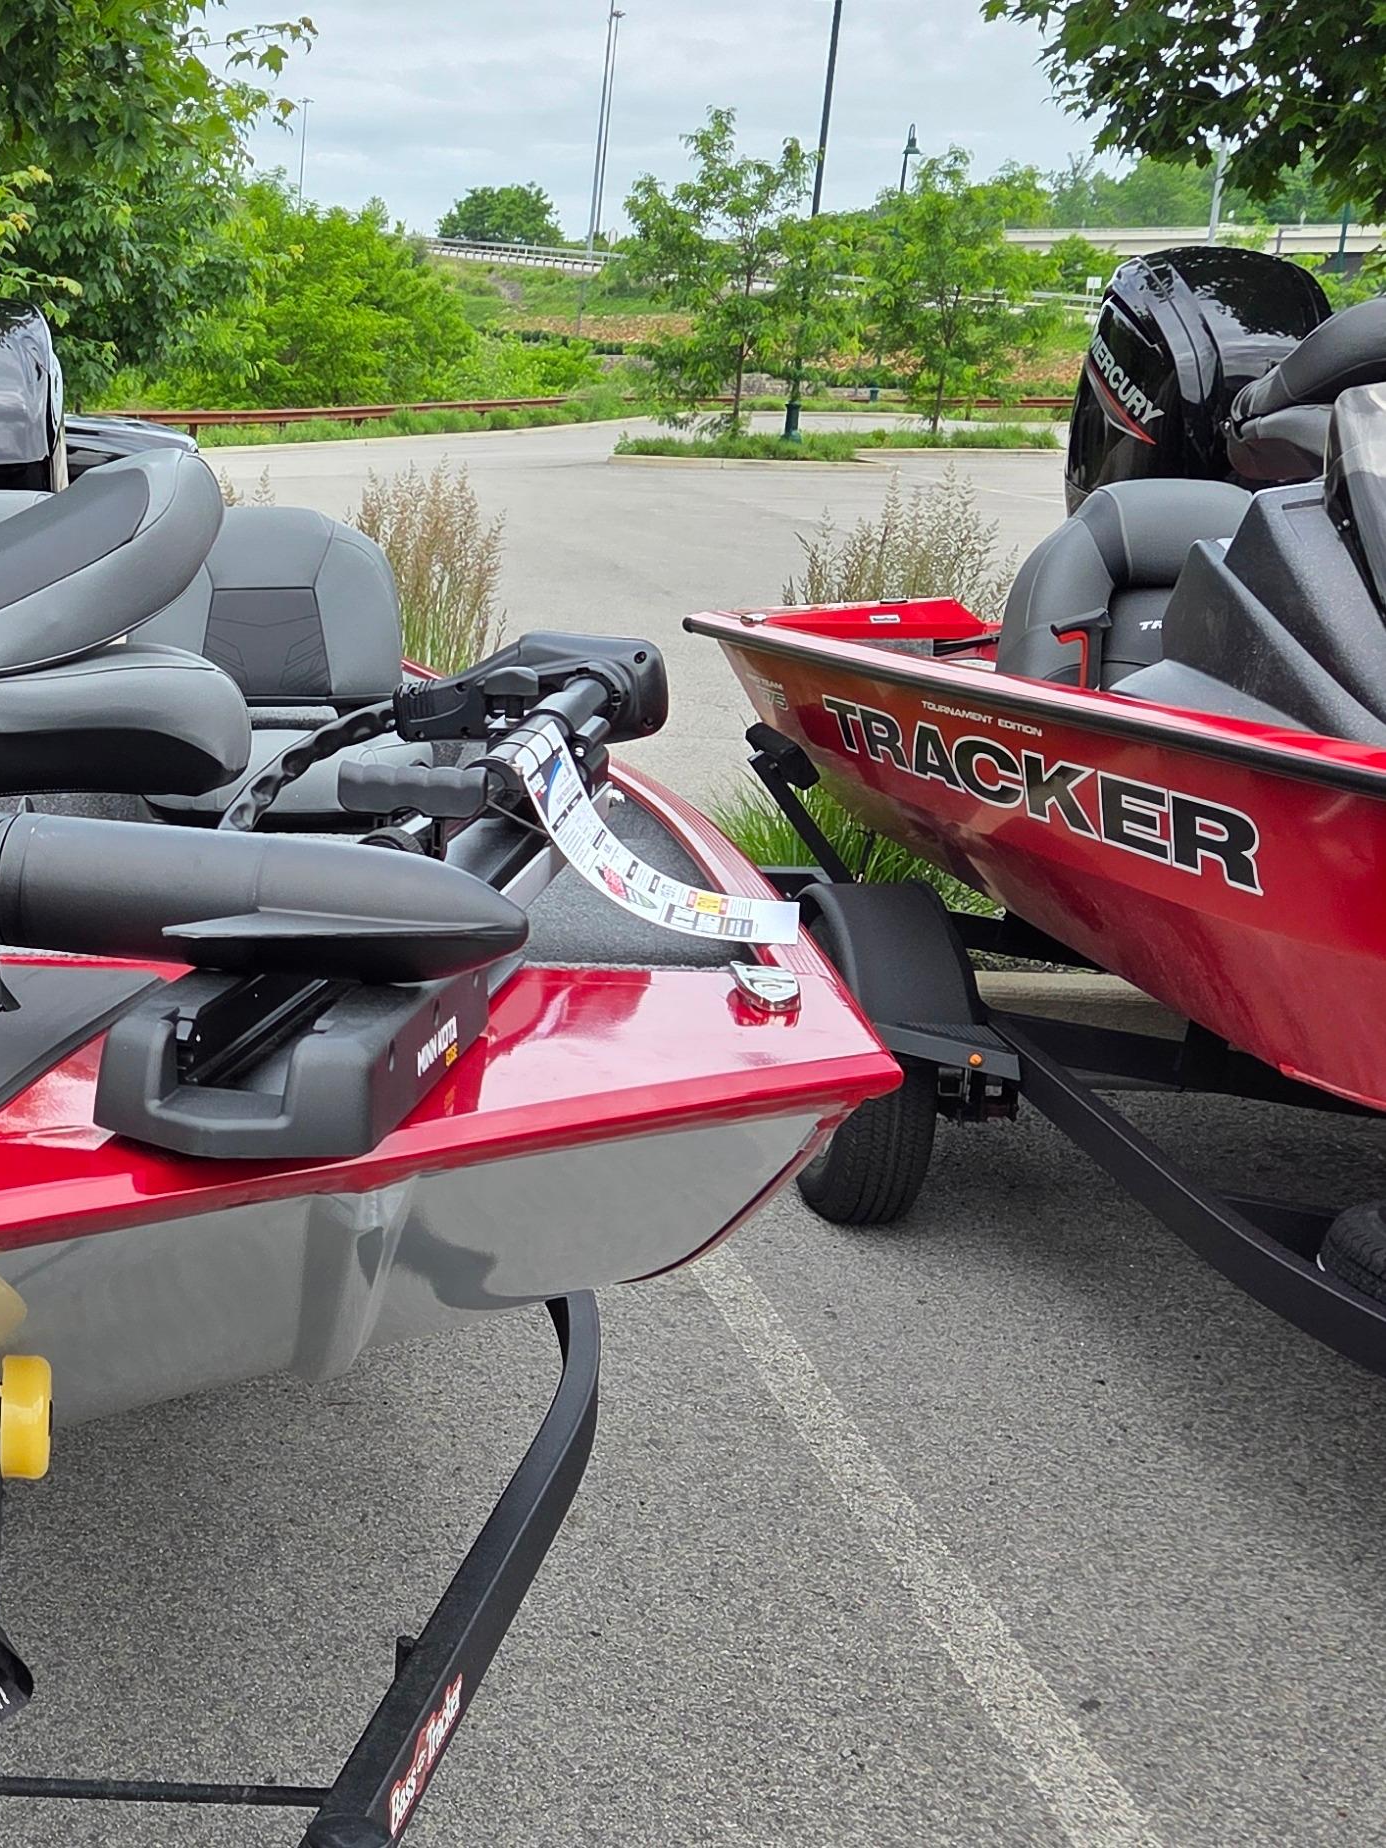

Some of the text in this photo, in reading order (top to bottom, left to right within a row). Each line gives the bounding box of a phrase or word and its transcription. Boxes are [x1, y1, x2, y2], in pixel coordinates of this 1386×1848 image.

[822, 694, 1263, 896] TRACKER
[921, 700, 1042, 737] TOURNAMENT EDITION
[390, 1679, 463, 1838] Bass Tracker
